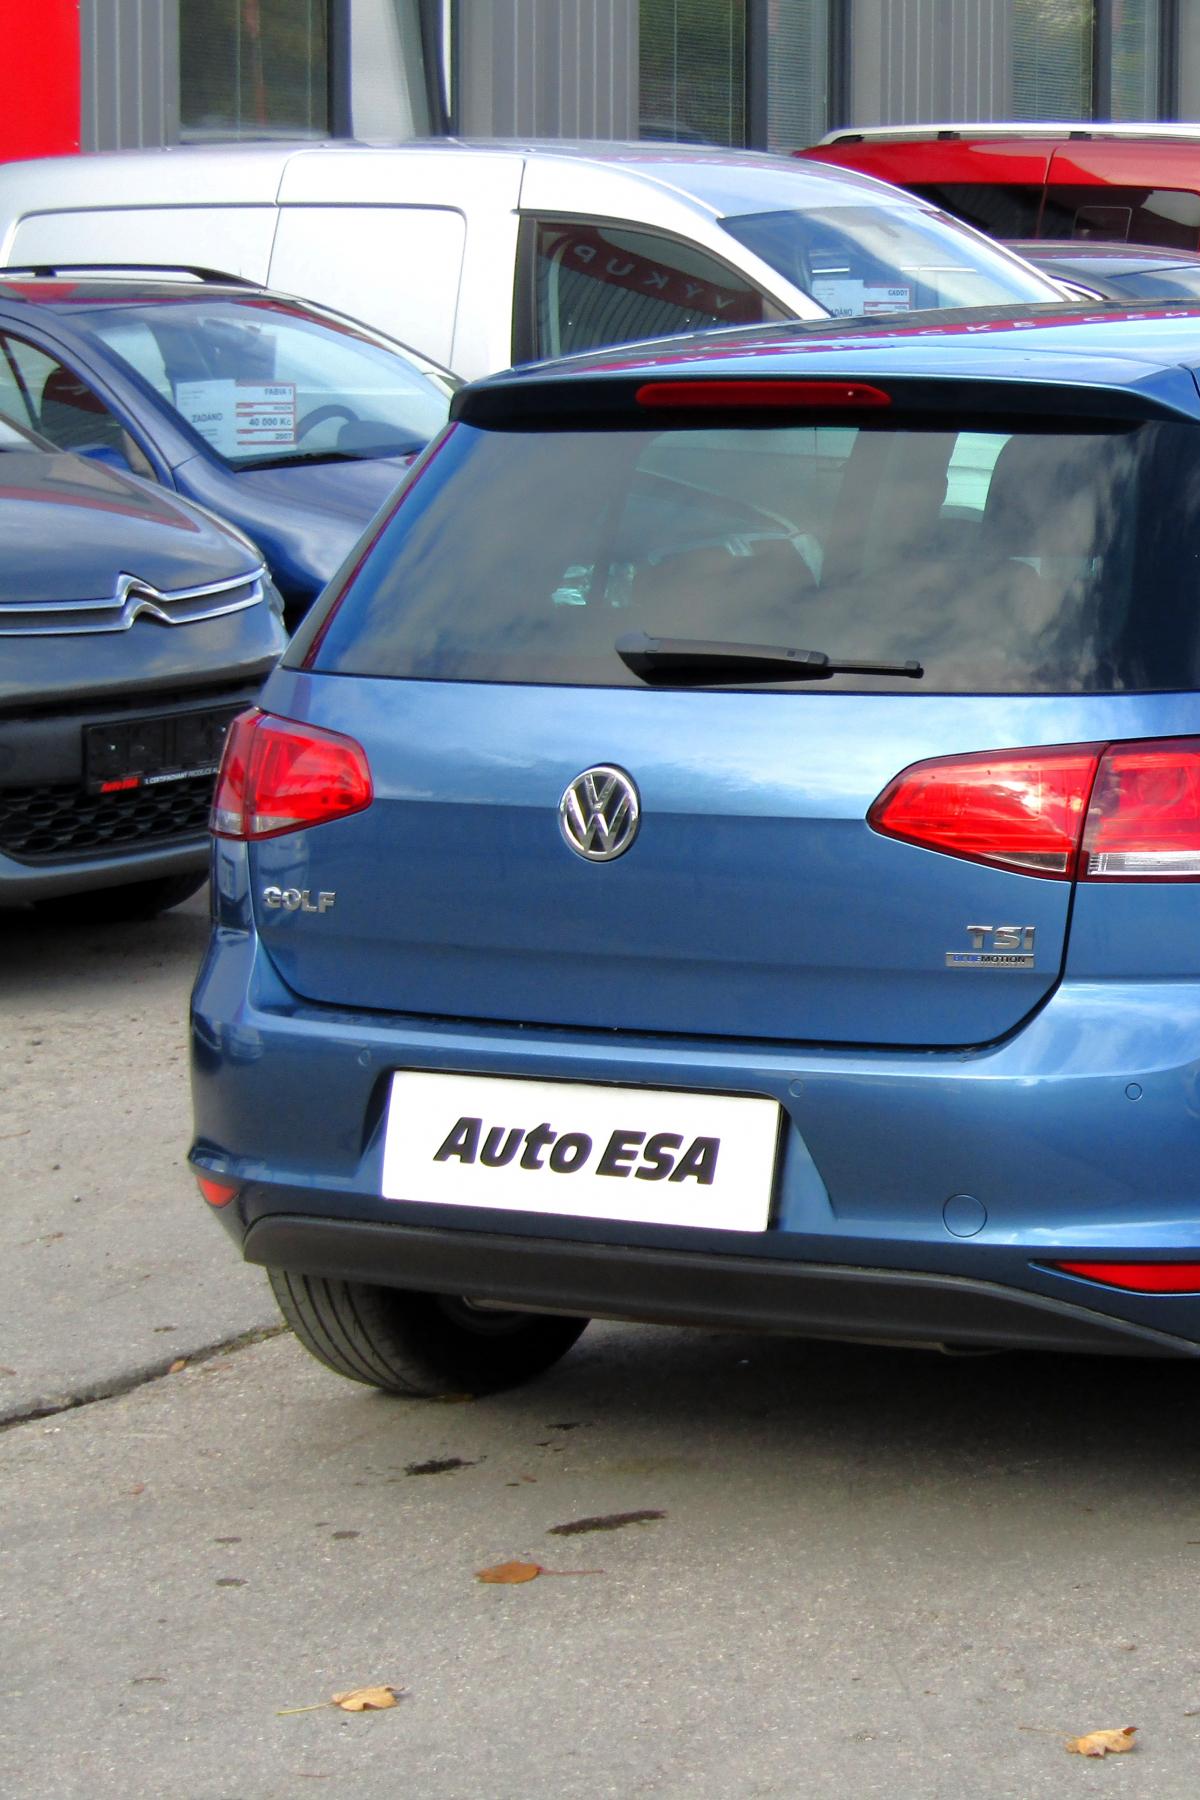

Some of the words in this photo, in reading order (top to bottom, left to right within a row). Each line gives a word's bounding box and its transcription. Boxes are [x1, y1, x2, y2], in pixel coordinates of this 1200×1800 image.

[264, 387, 287, 396] FABIA
[249, 417, 260, 426] 40
[261, 417, 278, 426] 000
[263, 886, 336, 913] GOLF
[966, 925, 1036, 950] TSI
[432, 1116, 593, 1174] Auto
[595, 1129, 721, 1185] ESA
